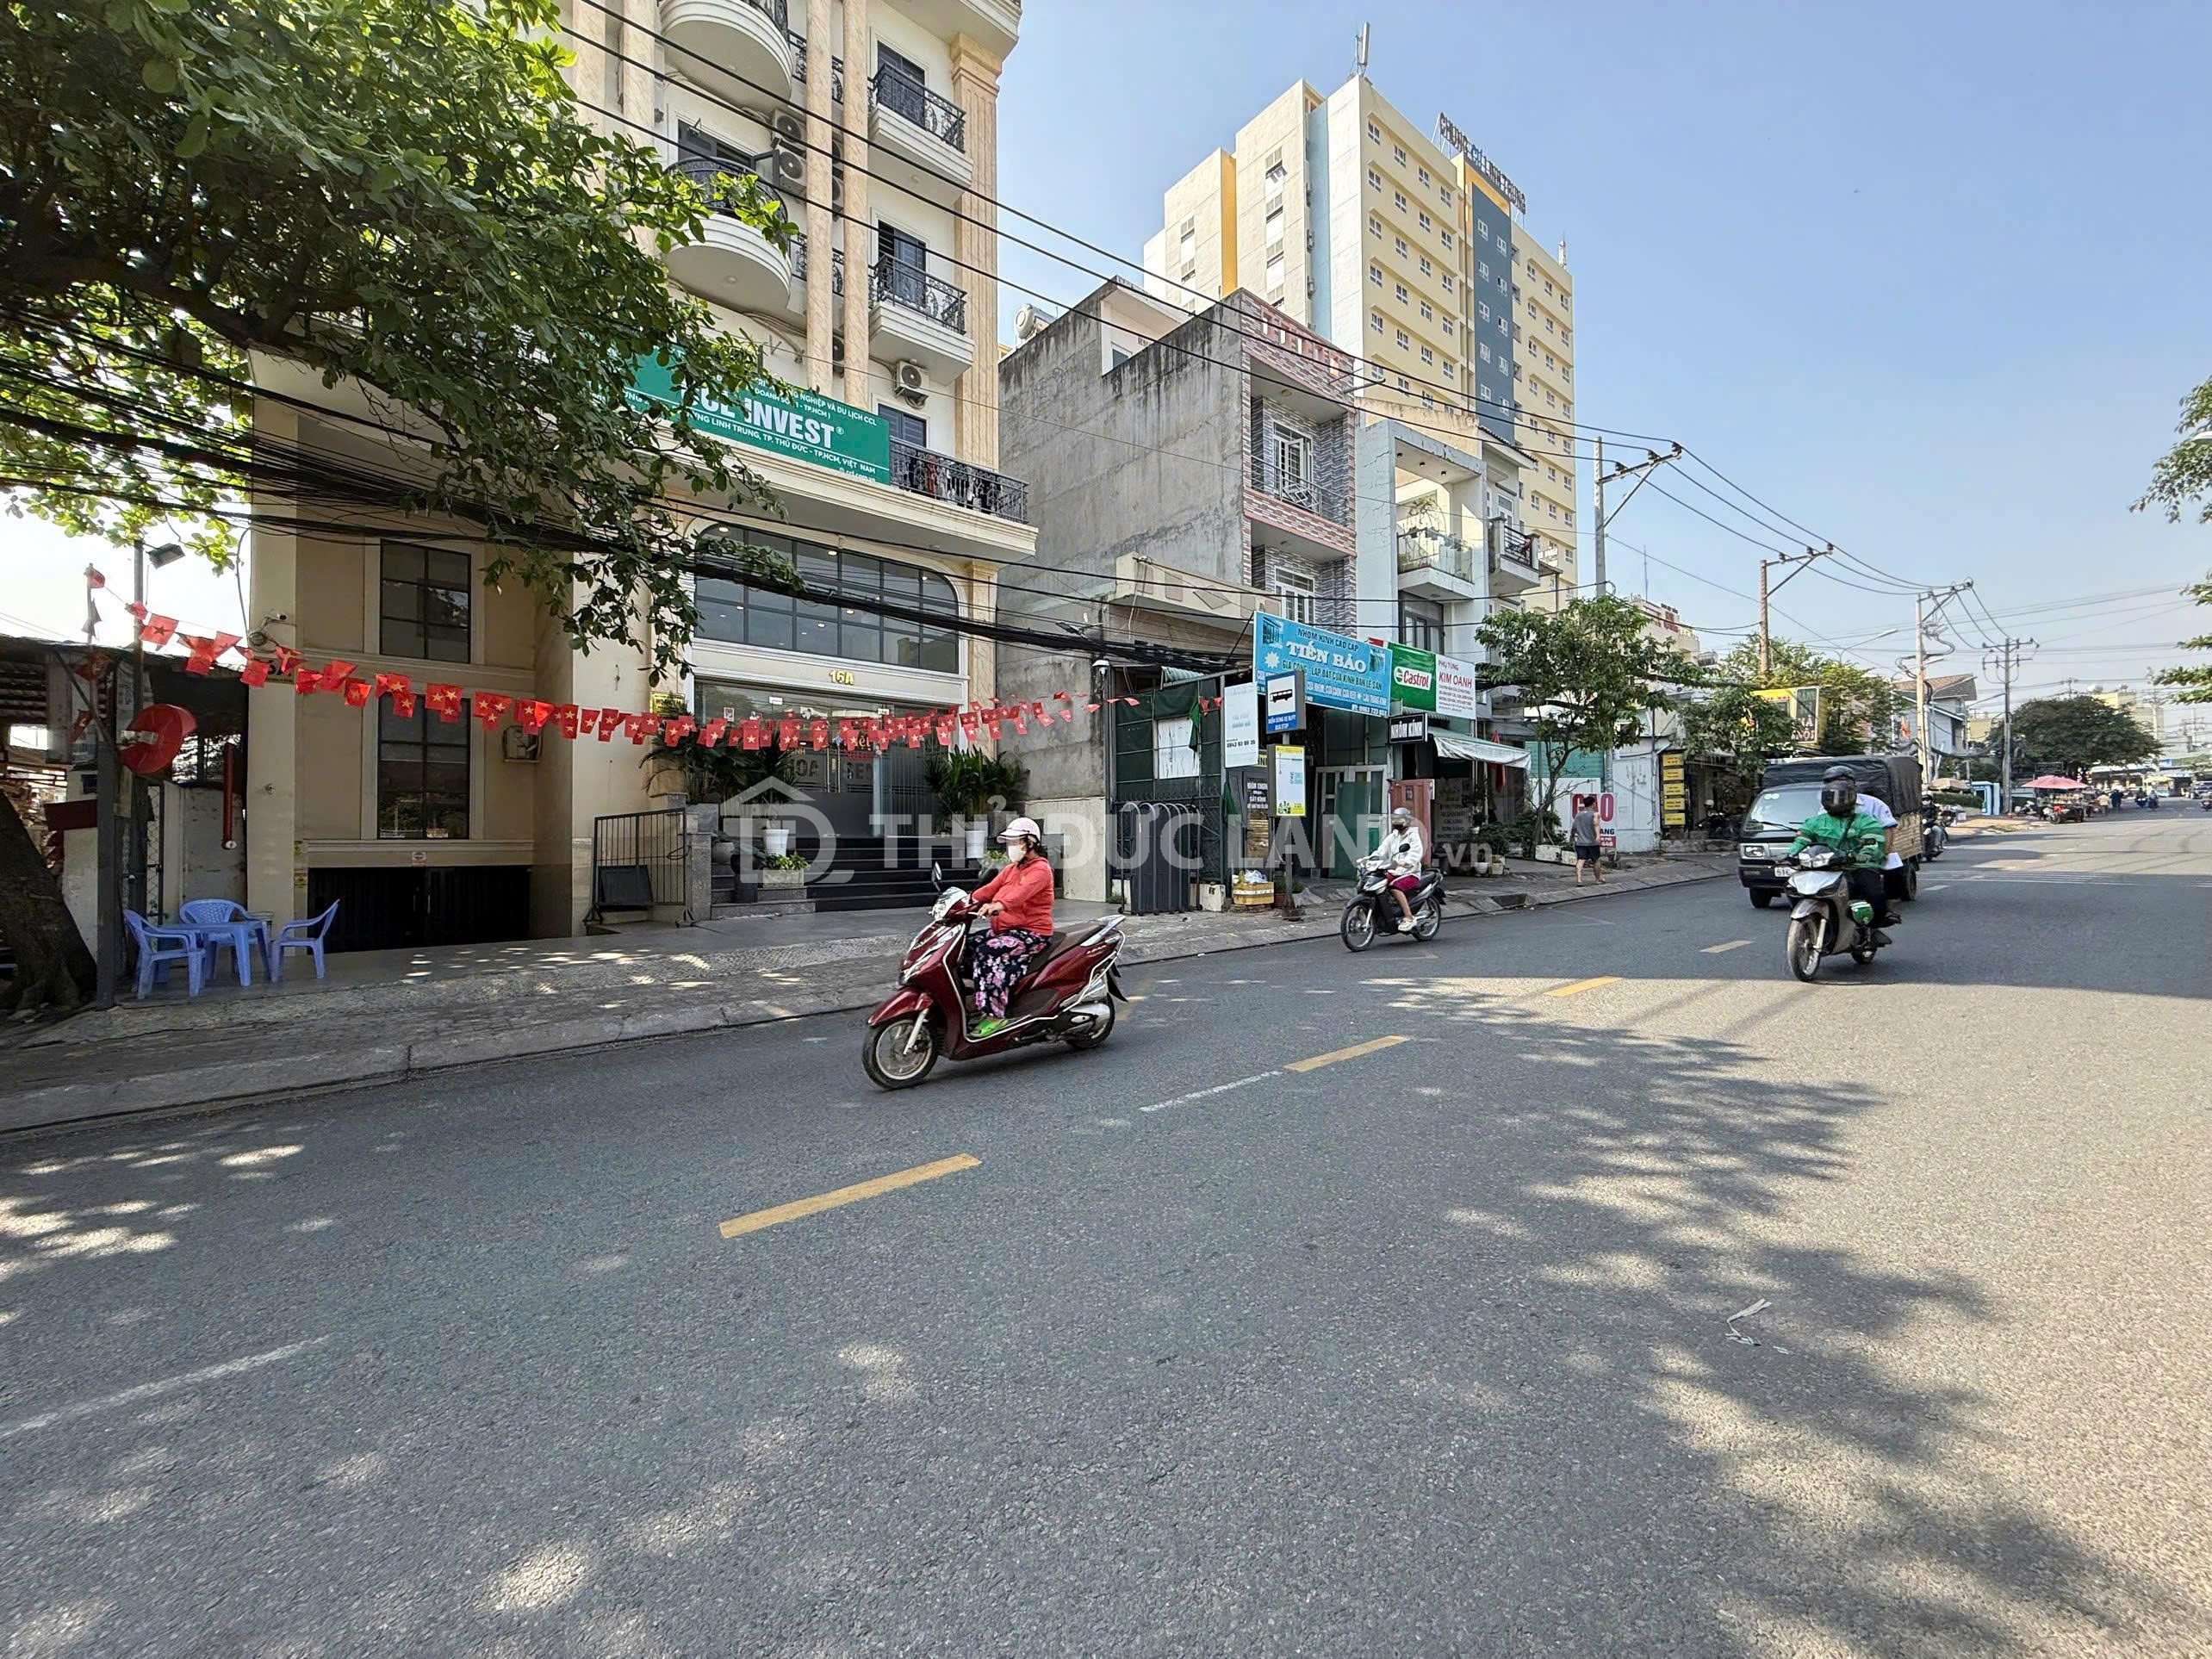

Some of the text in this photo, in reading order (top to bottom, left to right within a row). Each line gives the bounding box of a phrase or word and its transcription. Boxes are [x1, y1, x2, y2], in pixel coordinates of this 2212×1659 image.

[744, 397, 835, 449] INVEST
[837, 406, 848, 415] DU
[864, 416, 877, 426] CCL
[711, 419, 731, 430] LINH
[732, 425, 761, 440] TRUNG,
[763, 433, 774, 443] TP.
[842, 458, 857, 469] VIỆT
[860, 463, 876, 474] NAM
[1332, 653, 1367, 674] BẢO
[829, 669, 854, 686] 16A
[1403, 670, 1429, 688] Castrol
[1438, 672, 1472, 688] KIM OANH
